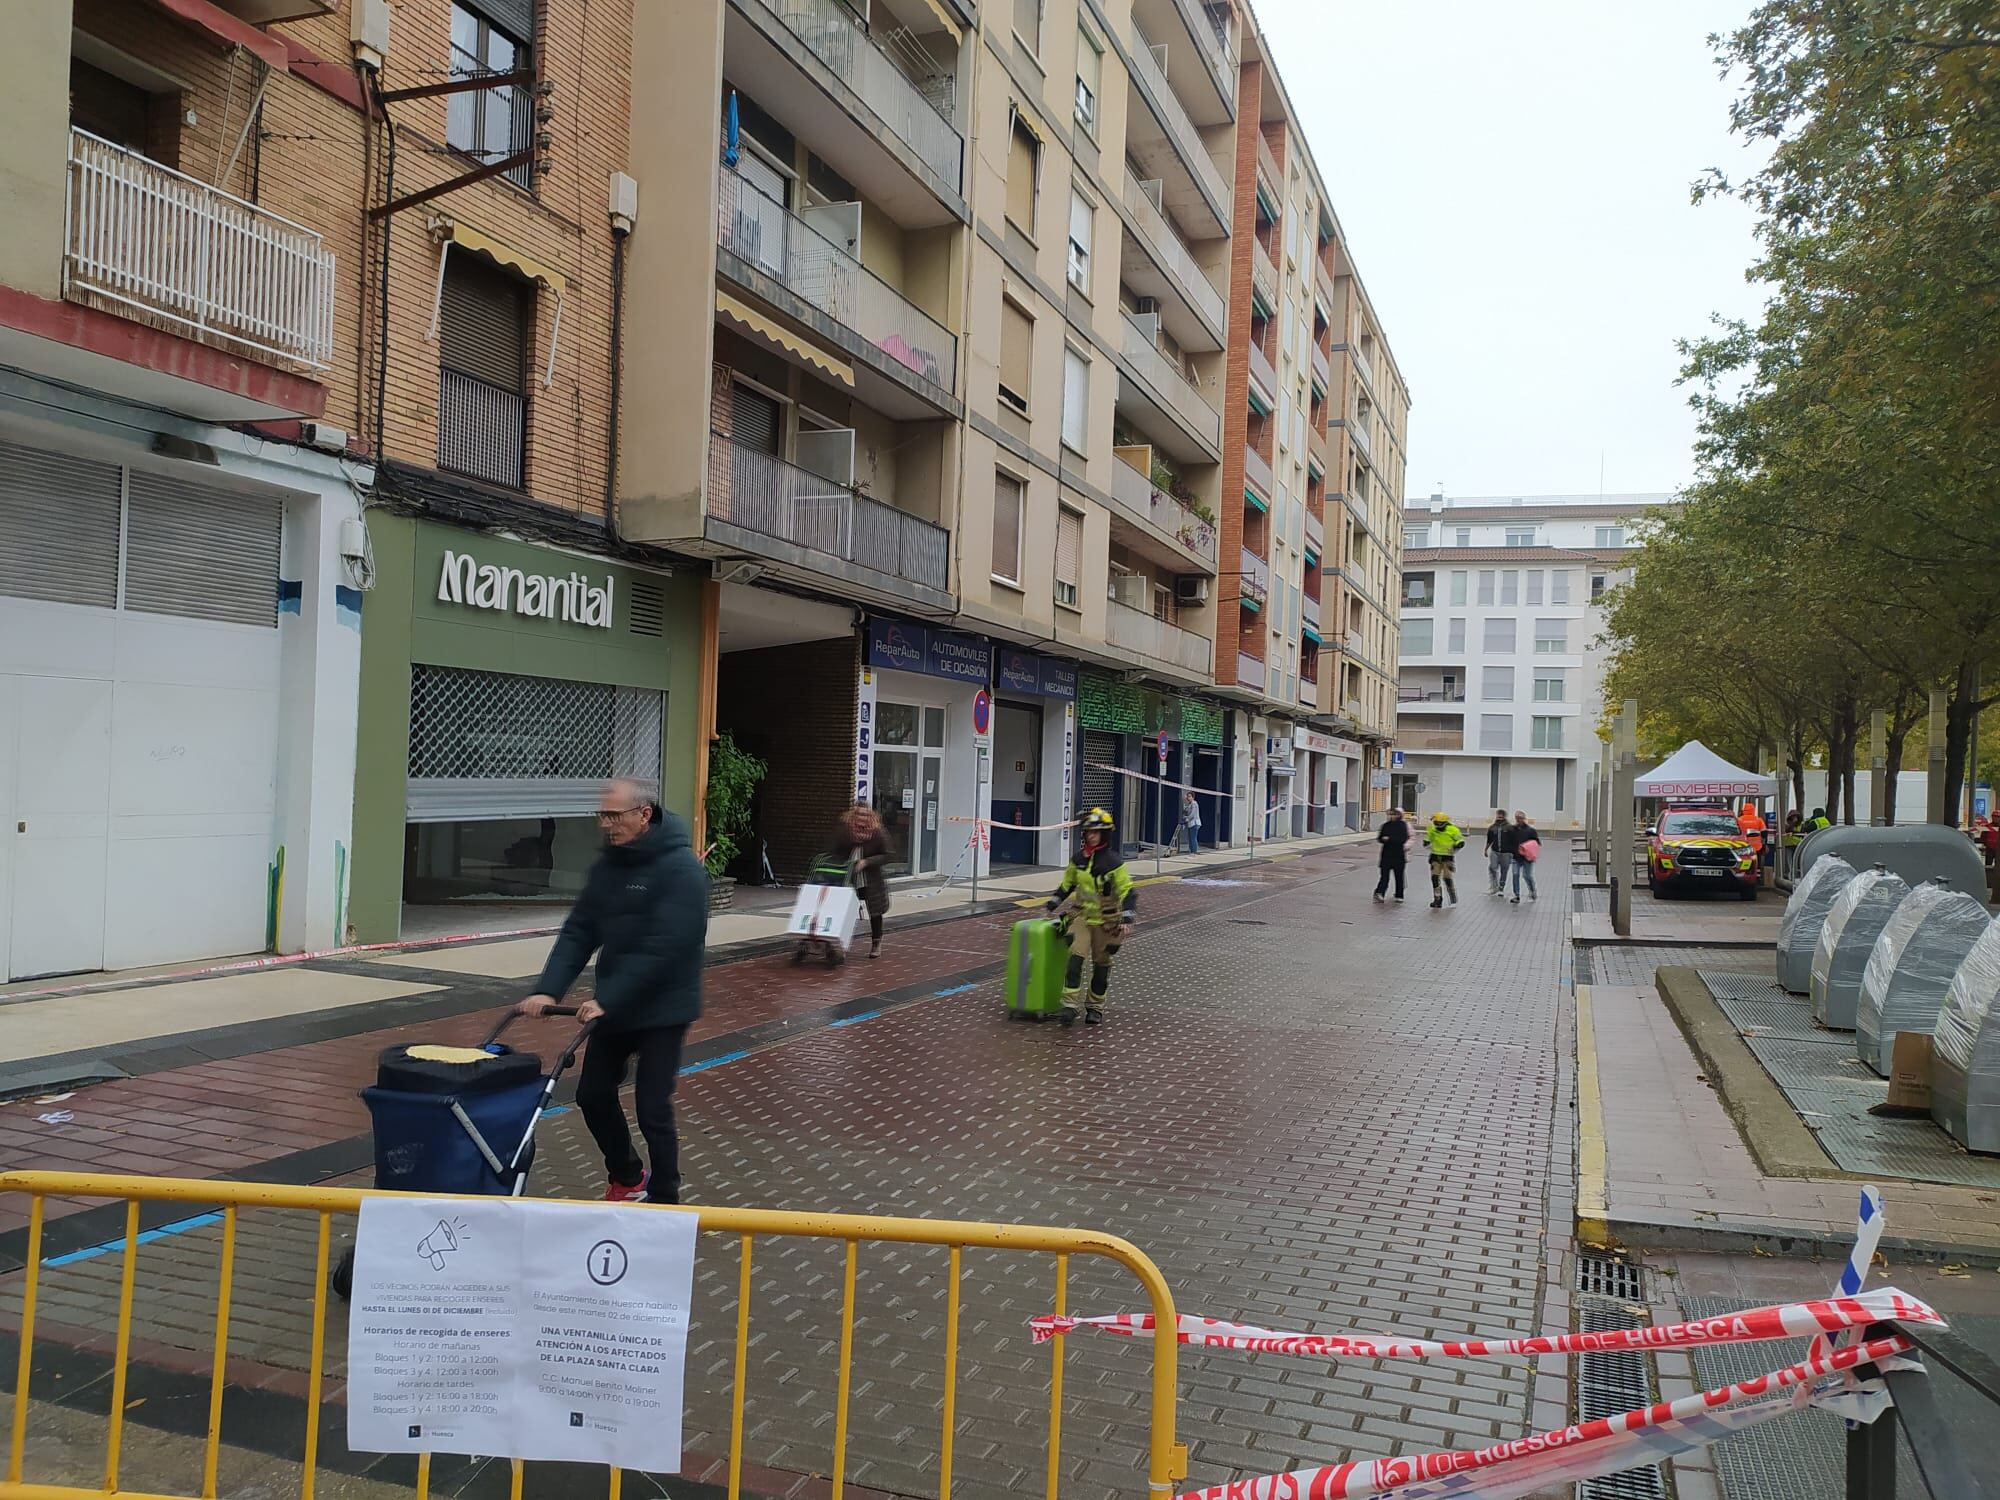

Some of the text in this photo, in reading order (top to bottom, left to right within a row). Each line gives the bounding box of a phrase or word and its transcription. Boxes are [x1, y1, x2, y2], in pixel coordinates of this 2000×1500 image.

[437, 550, 614, 629] Manantial
[876, 640, 920, 660] ReparAuto
[932, 641, 988, 661] AUTOMÓVILES
[940, 660, 987, 679] DE OCASIÓN
[1003, 669, 1035, 683] ReparAuto
[1055, 670, 1075, 682] TALLER
[1044, 680, 1074, 696] MECÁNICO
[1648, 784, 1759, 794] BOMBEROS
[542, 1292, 598, 1305] Ayuntamiento
[599, 1297, 610, 1306] de
[612, 1300, 644, 1309] Huesca
[645, 1302, 678, 1311] habilita
[534, 1303, 557, 1312] desde
[578, 1308, 606, 1318] martes
[608, 1311, 617, 1319] 02
[633, 1314, 676, 1324] diciembre
[364, 1326, 403, 1334] Horarios
[419, 1328, 458, 1338] recogida
[541, 1326, 561, 1335] UNA
[563, 1328, 617, 1342] VENTANILLA
[619, 1333, 648, 1345] ÚNICA
[1626, 1317, 1753, 1346] HUESCA
[394, 1341, 425, 1349] Horario
[441, 1341, 480, 1350] mañanas
[536, 1339, 583, 1351] ATENCIÓN
[593, 1345, 609, 1355] LOS
[611, 1349, 666, 1360] AFECTADOS
[376, 1353, 408, 1363] Bloques
[436, 1355, 459, 1363] 10:00
[470, 1355, 498, 1364] 12:00h
[566, 1356, 595, 1366] PLAZA
[597, 1360, 626, 1371] SANTA
[629, 1364, 660, 1374] CLARA
[374, 1367, 407, 1377] Bloques
[561, 1376, 594, 1387] Manuel
[595, 1379, 623, 1390] Benito
[625, 1384, 657, 1395] Moliner
[373, 1392, 408, 1402] Bloques
[539, 1385, 557, 1394] 9:00
[567, 1389, 593, 1399] 14:00h
[603, 1394, 623, 1403] 17:00
[633, 1398, 660, 1409] 19:00h
[373, 1405, 408, 1414] Bloques
[470, 1405, 497, 1414] 20:00h
[594, 1424, 617, 1433] Huesca
[1435, 1425, 1585, 1474] DE HUESCA
